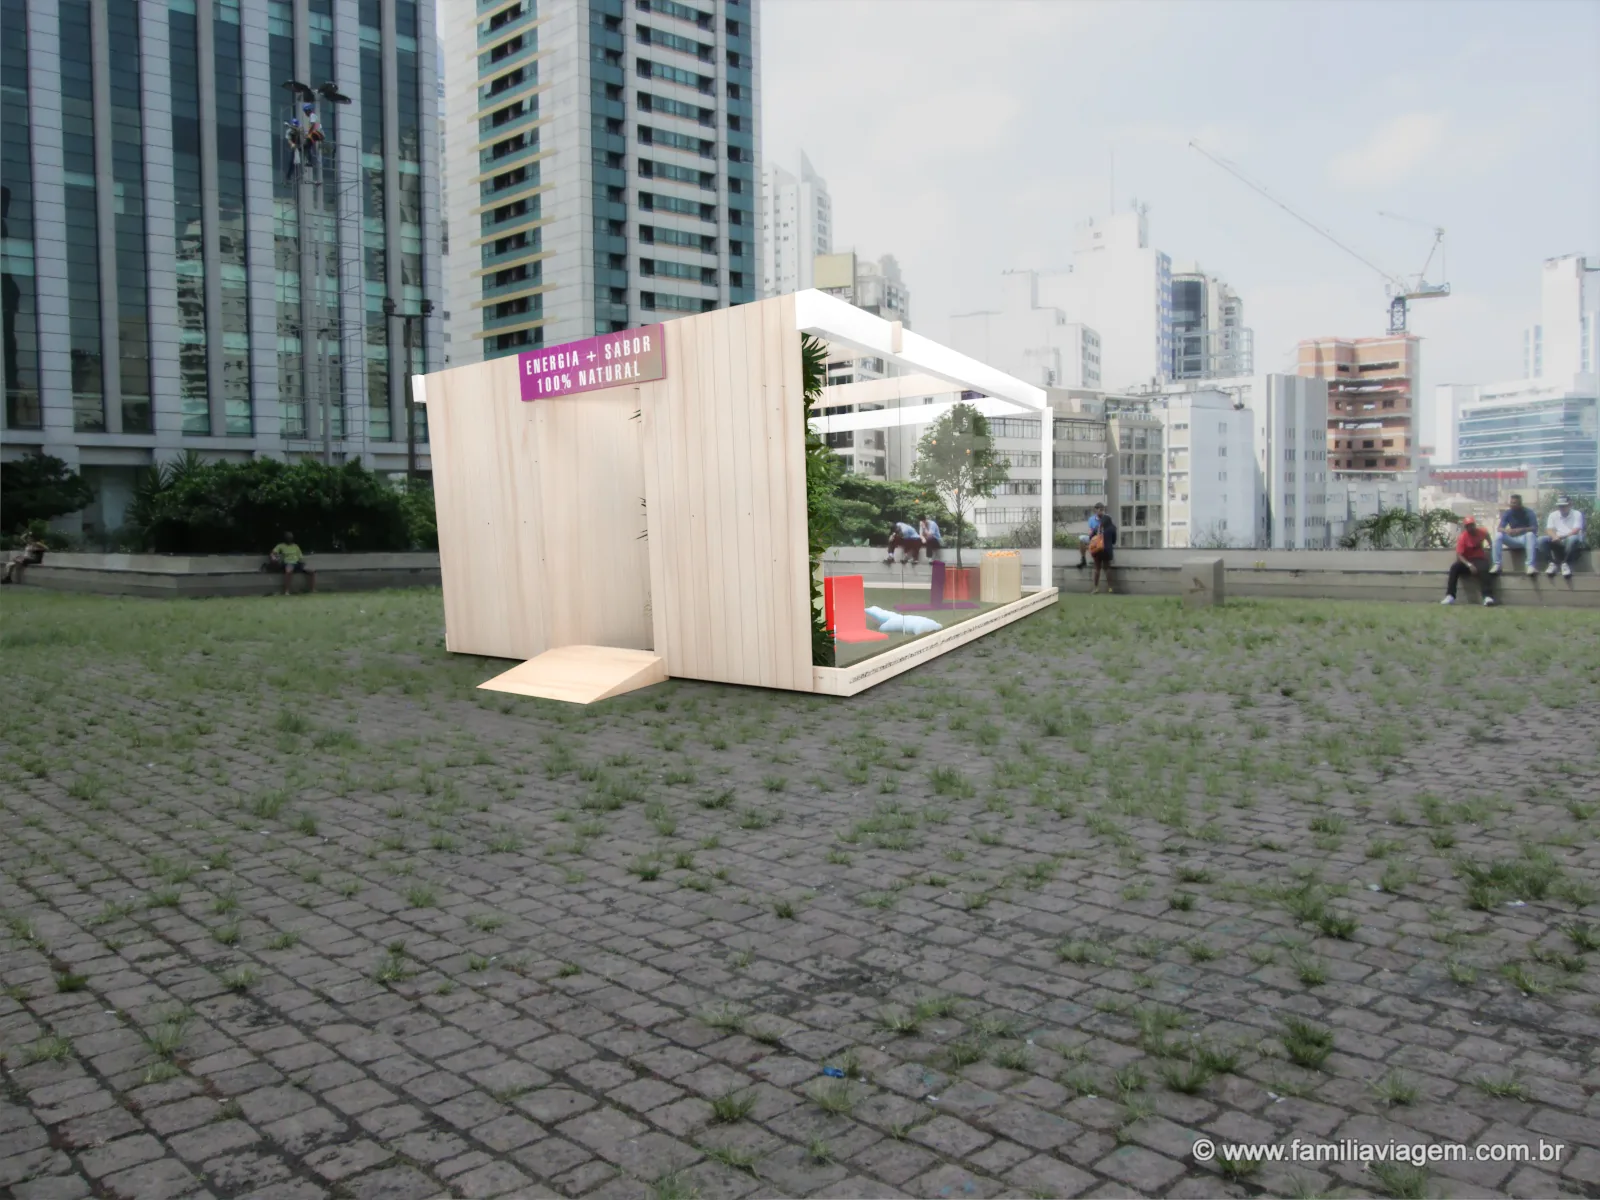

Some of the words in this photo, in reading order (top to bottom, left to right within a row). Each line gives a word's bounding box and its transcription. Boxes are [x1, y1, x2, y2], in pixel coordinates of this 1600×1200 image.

[526, 350, 579, 375] ENERGIA
[604, 335, 651, 360] SABOR
[537, 374, 571, 393] 100%
[578, 361, 640, 386] NATURAL
